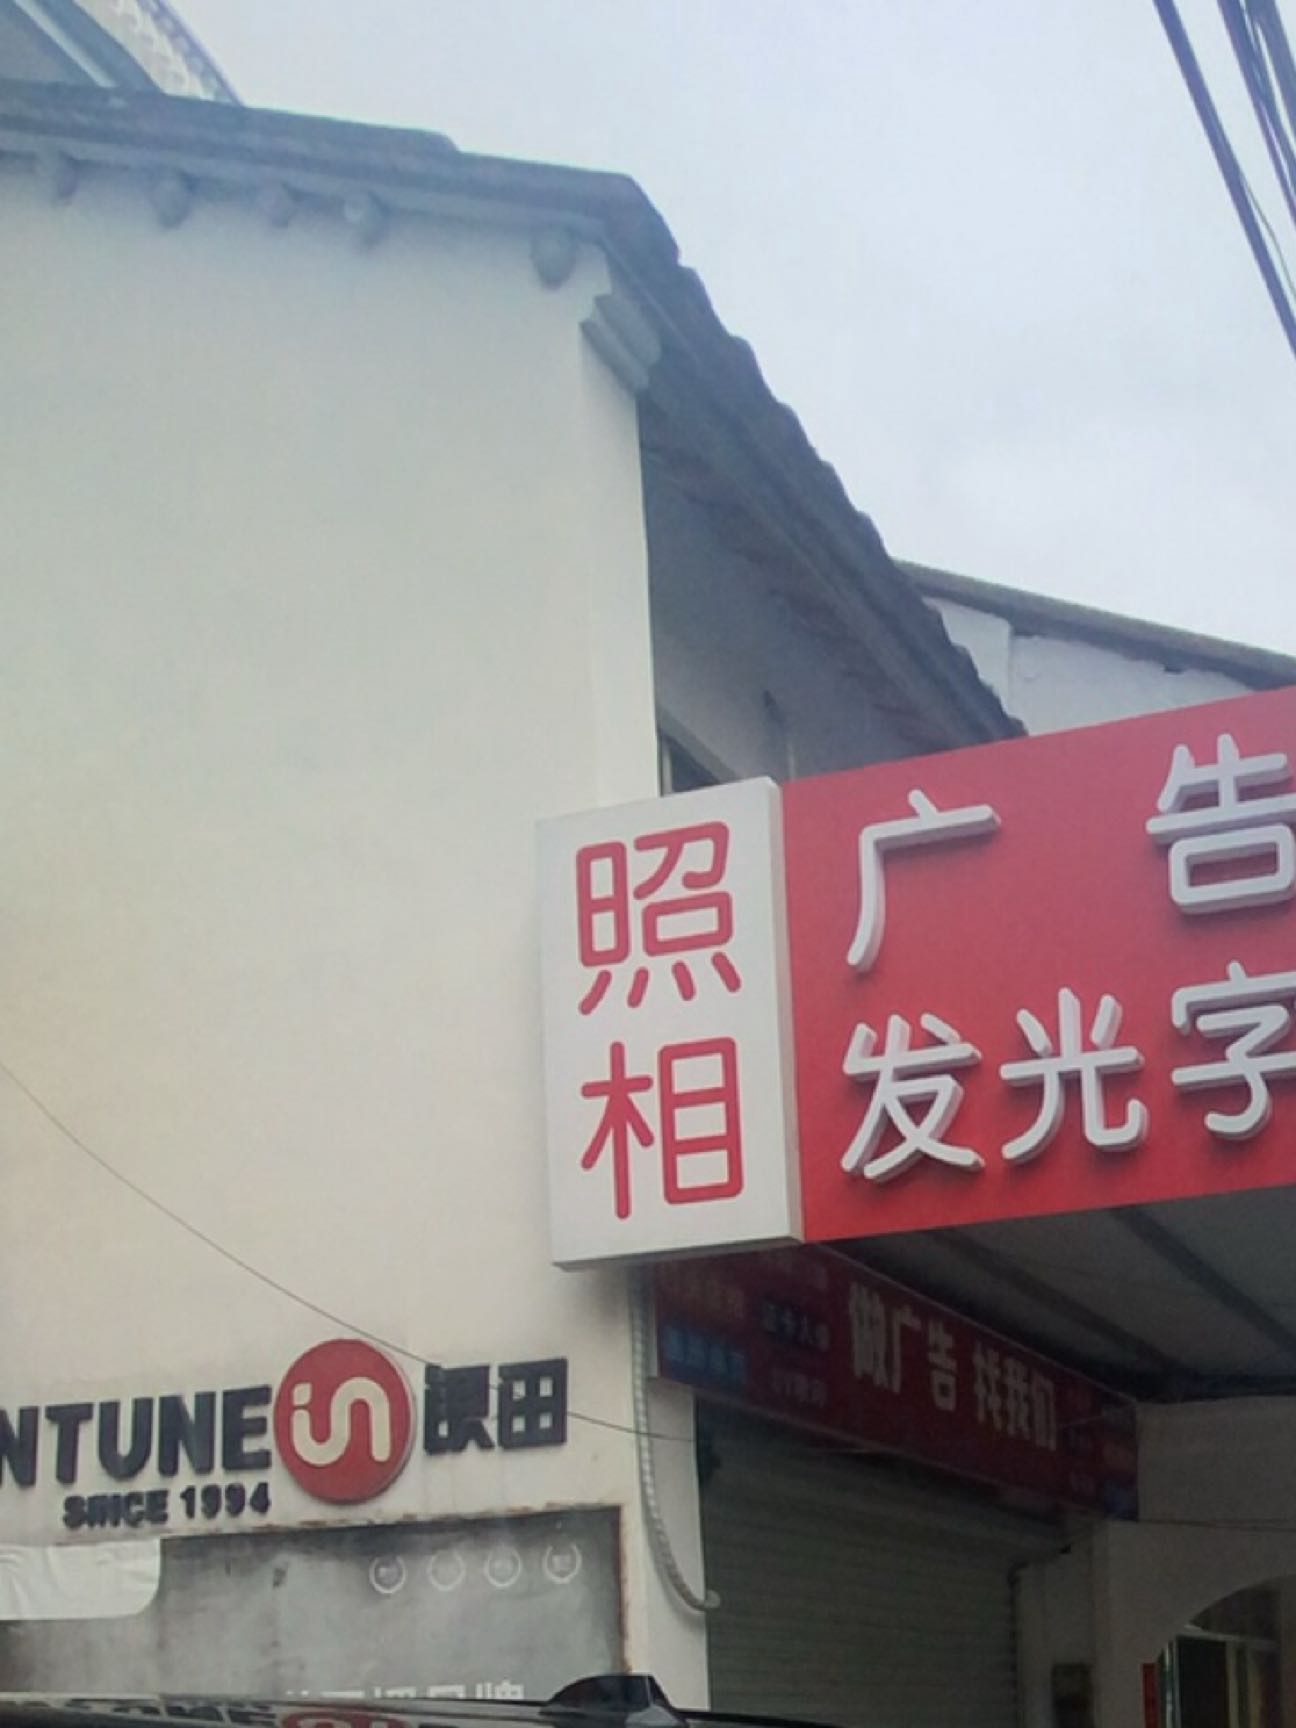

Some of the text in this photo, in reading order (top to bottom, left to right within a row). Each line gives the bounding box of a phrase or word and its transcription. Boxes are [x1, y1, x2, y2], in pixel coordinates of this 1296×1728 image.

[573, 817, 744, 1222] 照相
[63, 1482, 271, 1529] SINCE 1994
